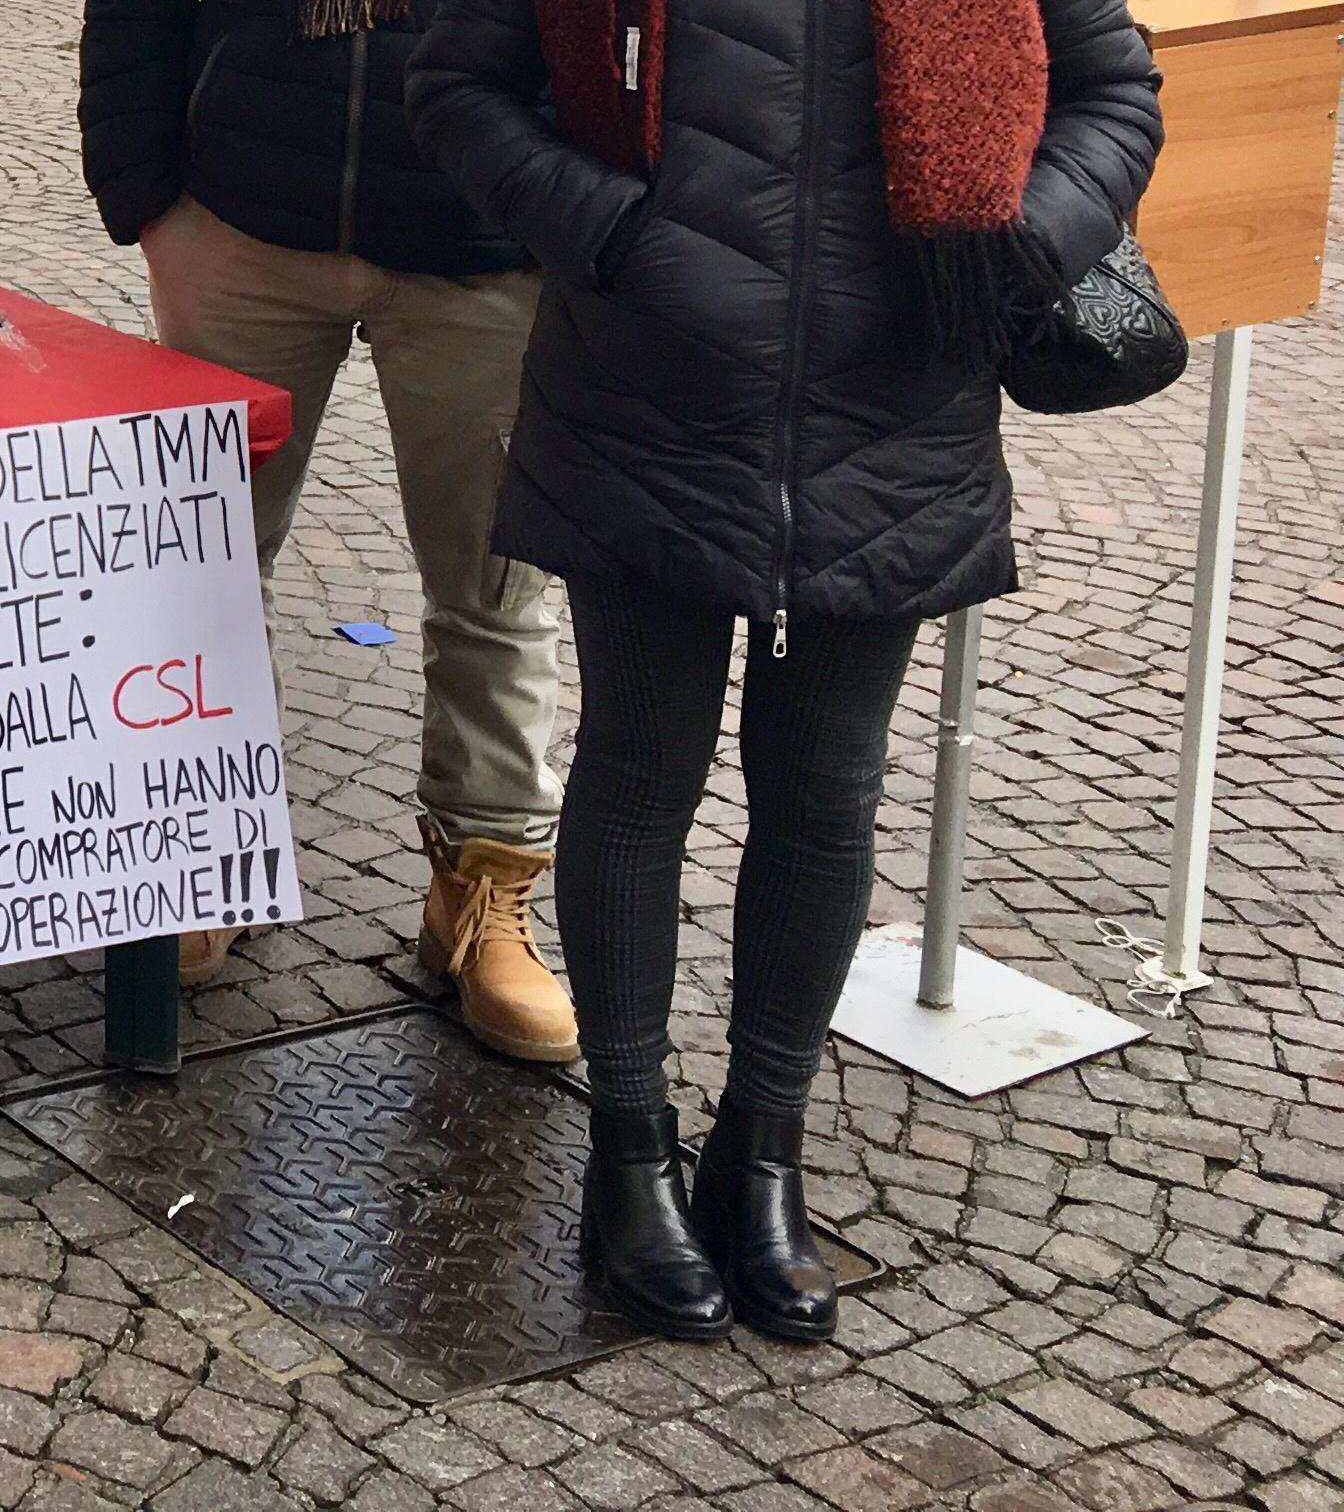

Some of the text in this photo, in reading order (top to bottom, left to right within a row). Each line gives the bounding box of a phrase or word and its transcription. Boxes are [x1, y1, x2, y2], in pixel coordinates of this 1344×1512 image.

[119, 407, 246, 488] TMM
[112, 654, 233, 730] CSL
[51, 763, 116, 824] NON
[143, 740, 280, 810] HANNO
[234, 808, 268, 849] DI
